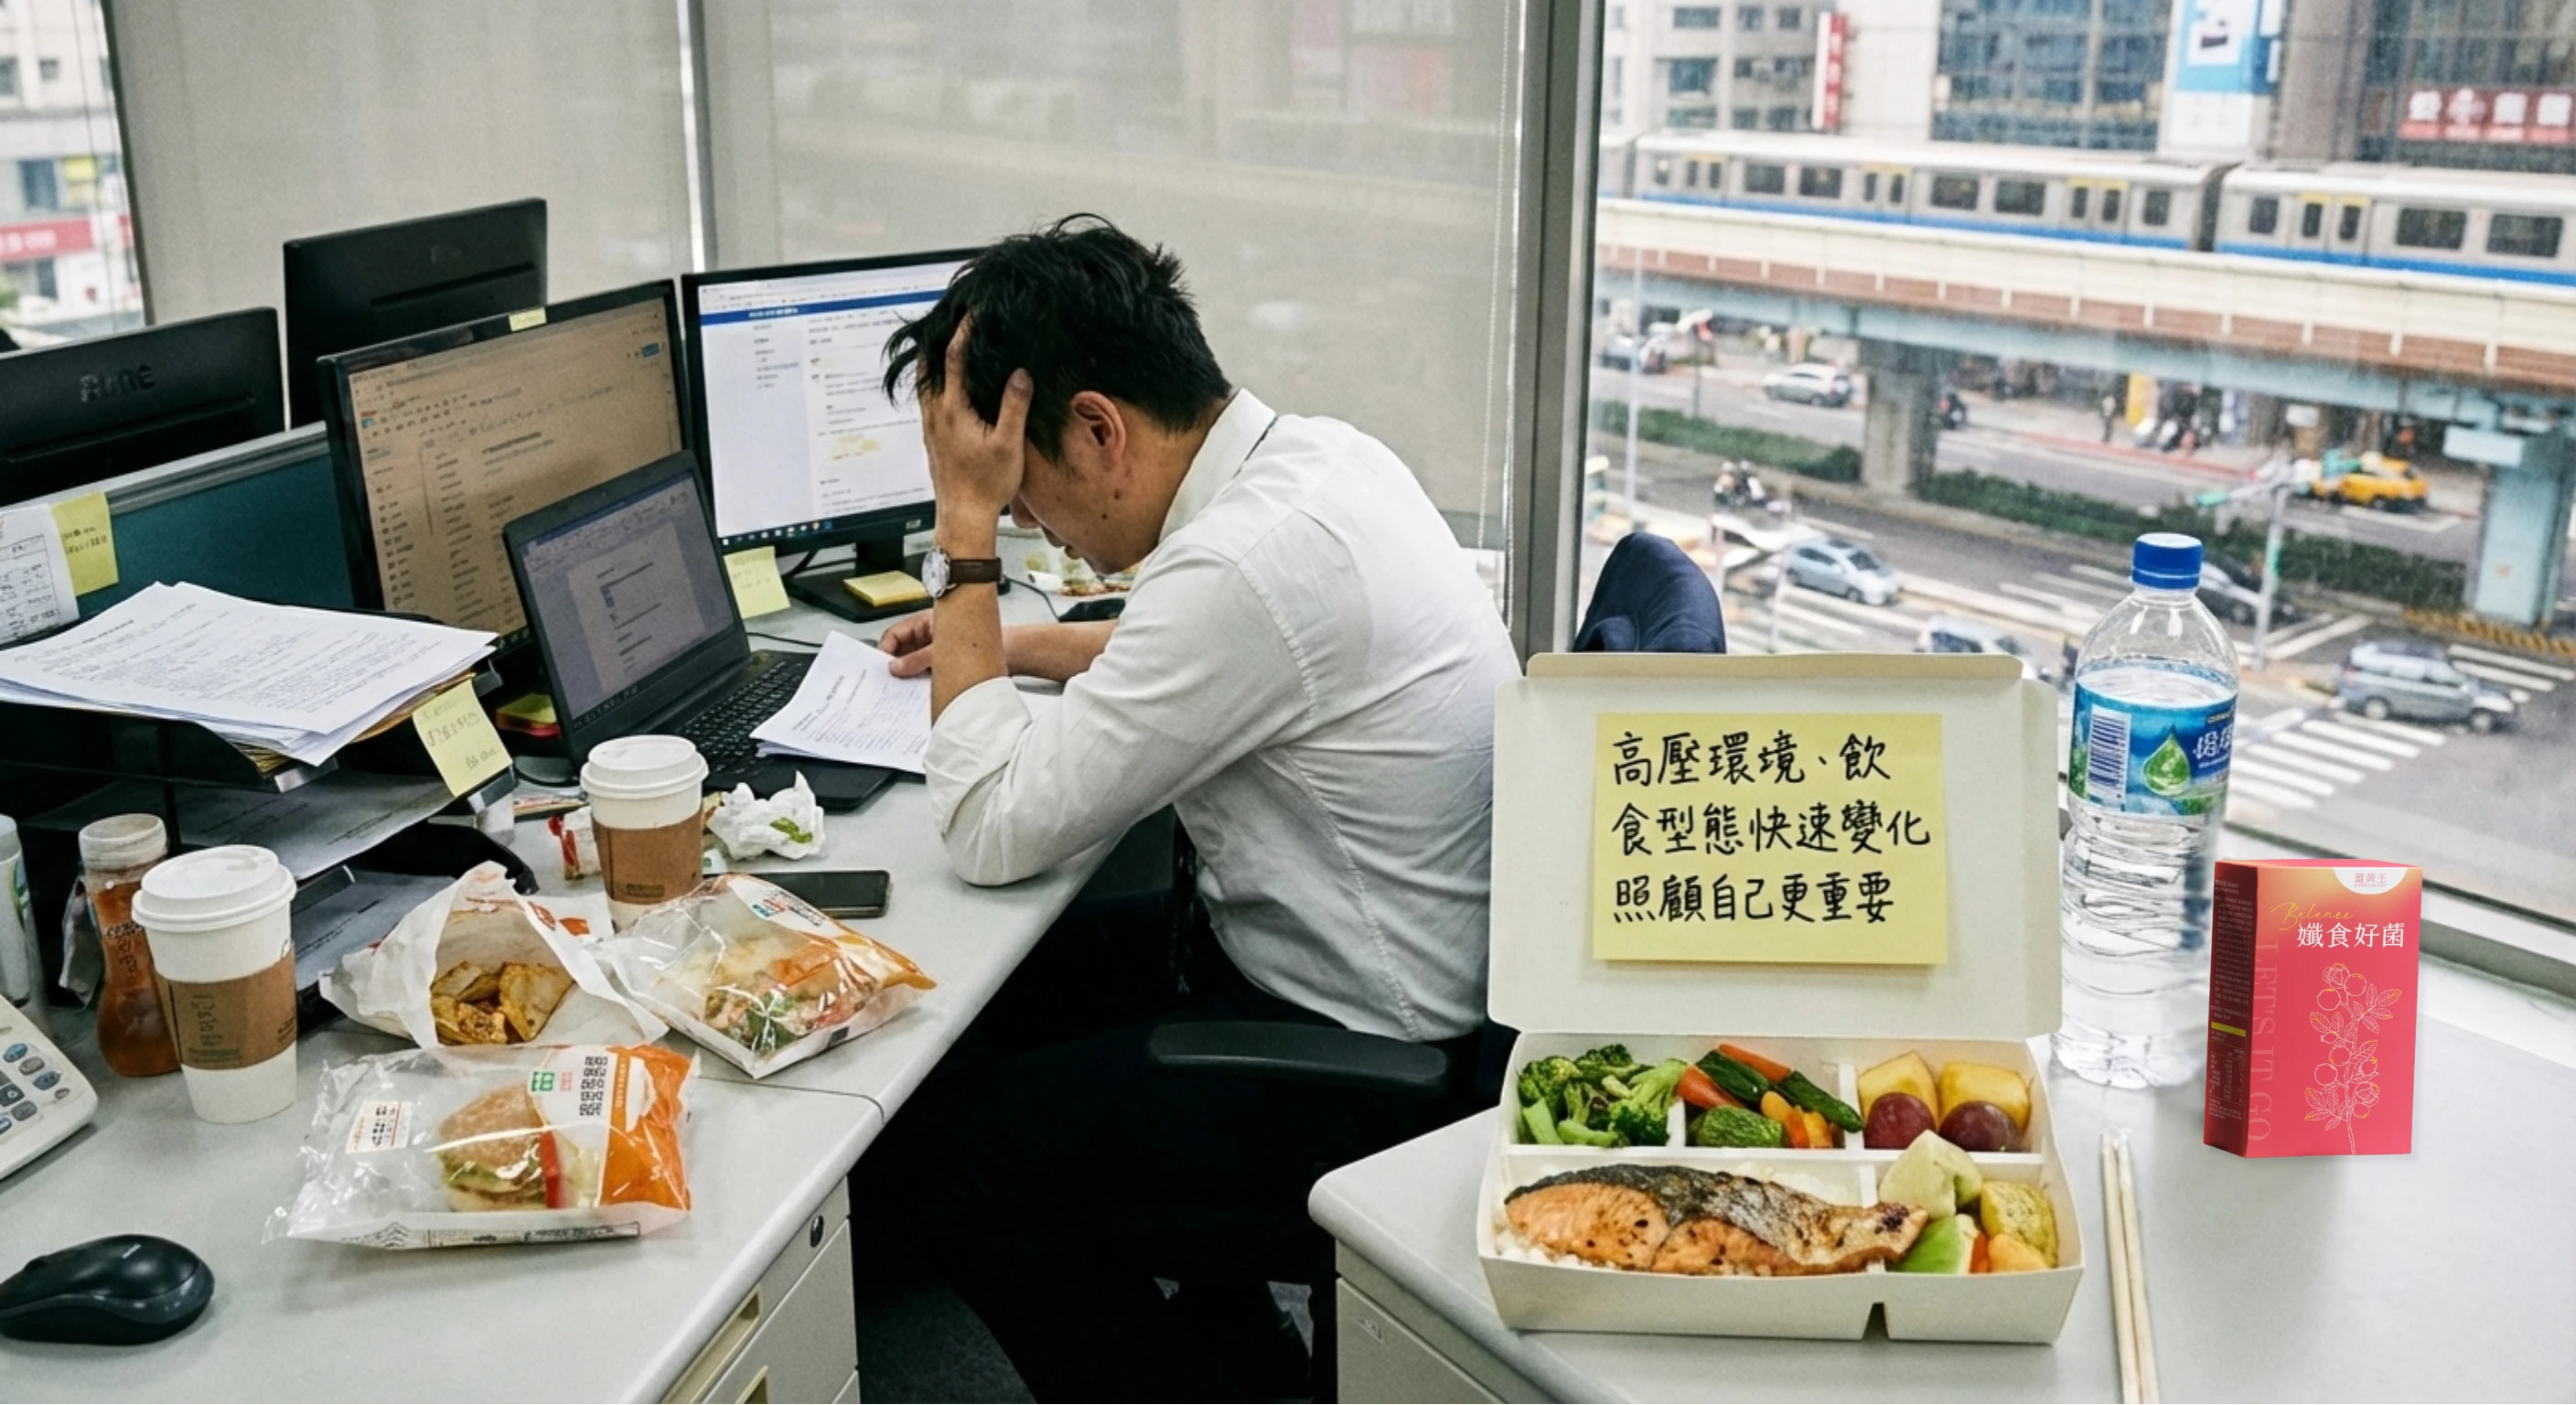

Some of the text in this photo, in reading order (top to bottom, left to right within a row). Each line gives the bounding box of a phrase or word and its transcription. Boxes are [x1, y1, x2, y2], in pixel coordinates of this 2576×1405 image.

[1612, 729, 1892, 788] 高壓環境、飲
[1611, 799, 1932, 857] 食型態快速變化
[1613, 871, 1894, 924] 照顧自己更重要
[2270, 901, 2356, 931] Balance
[2247, 940, 2279, 1142] LET'S IT GO
